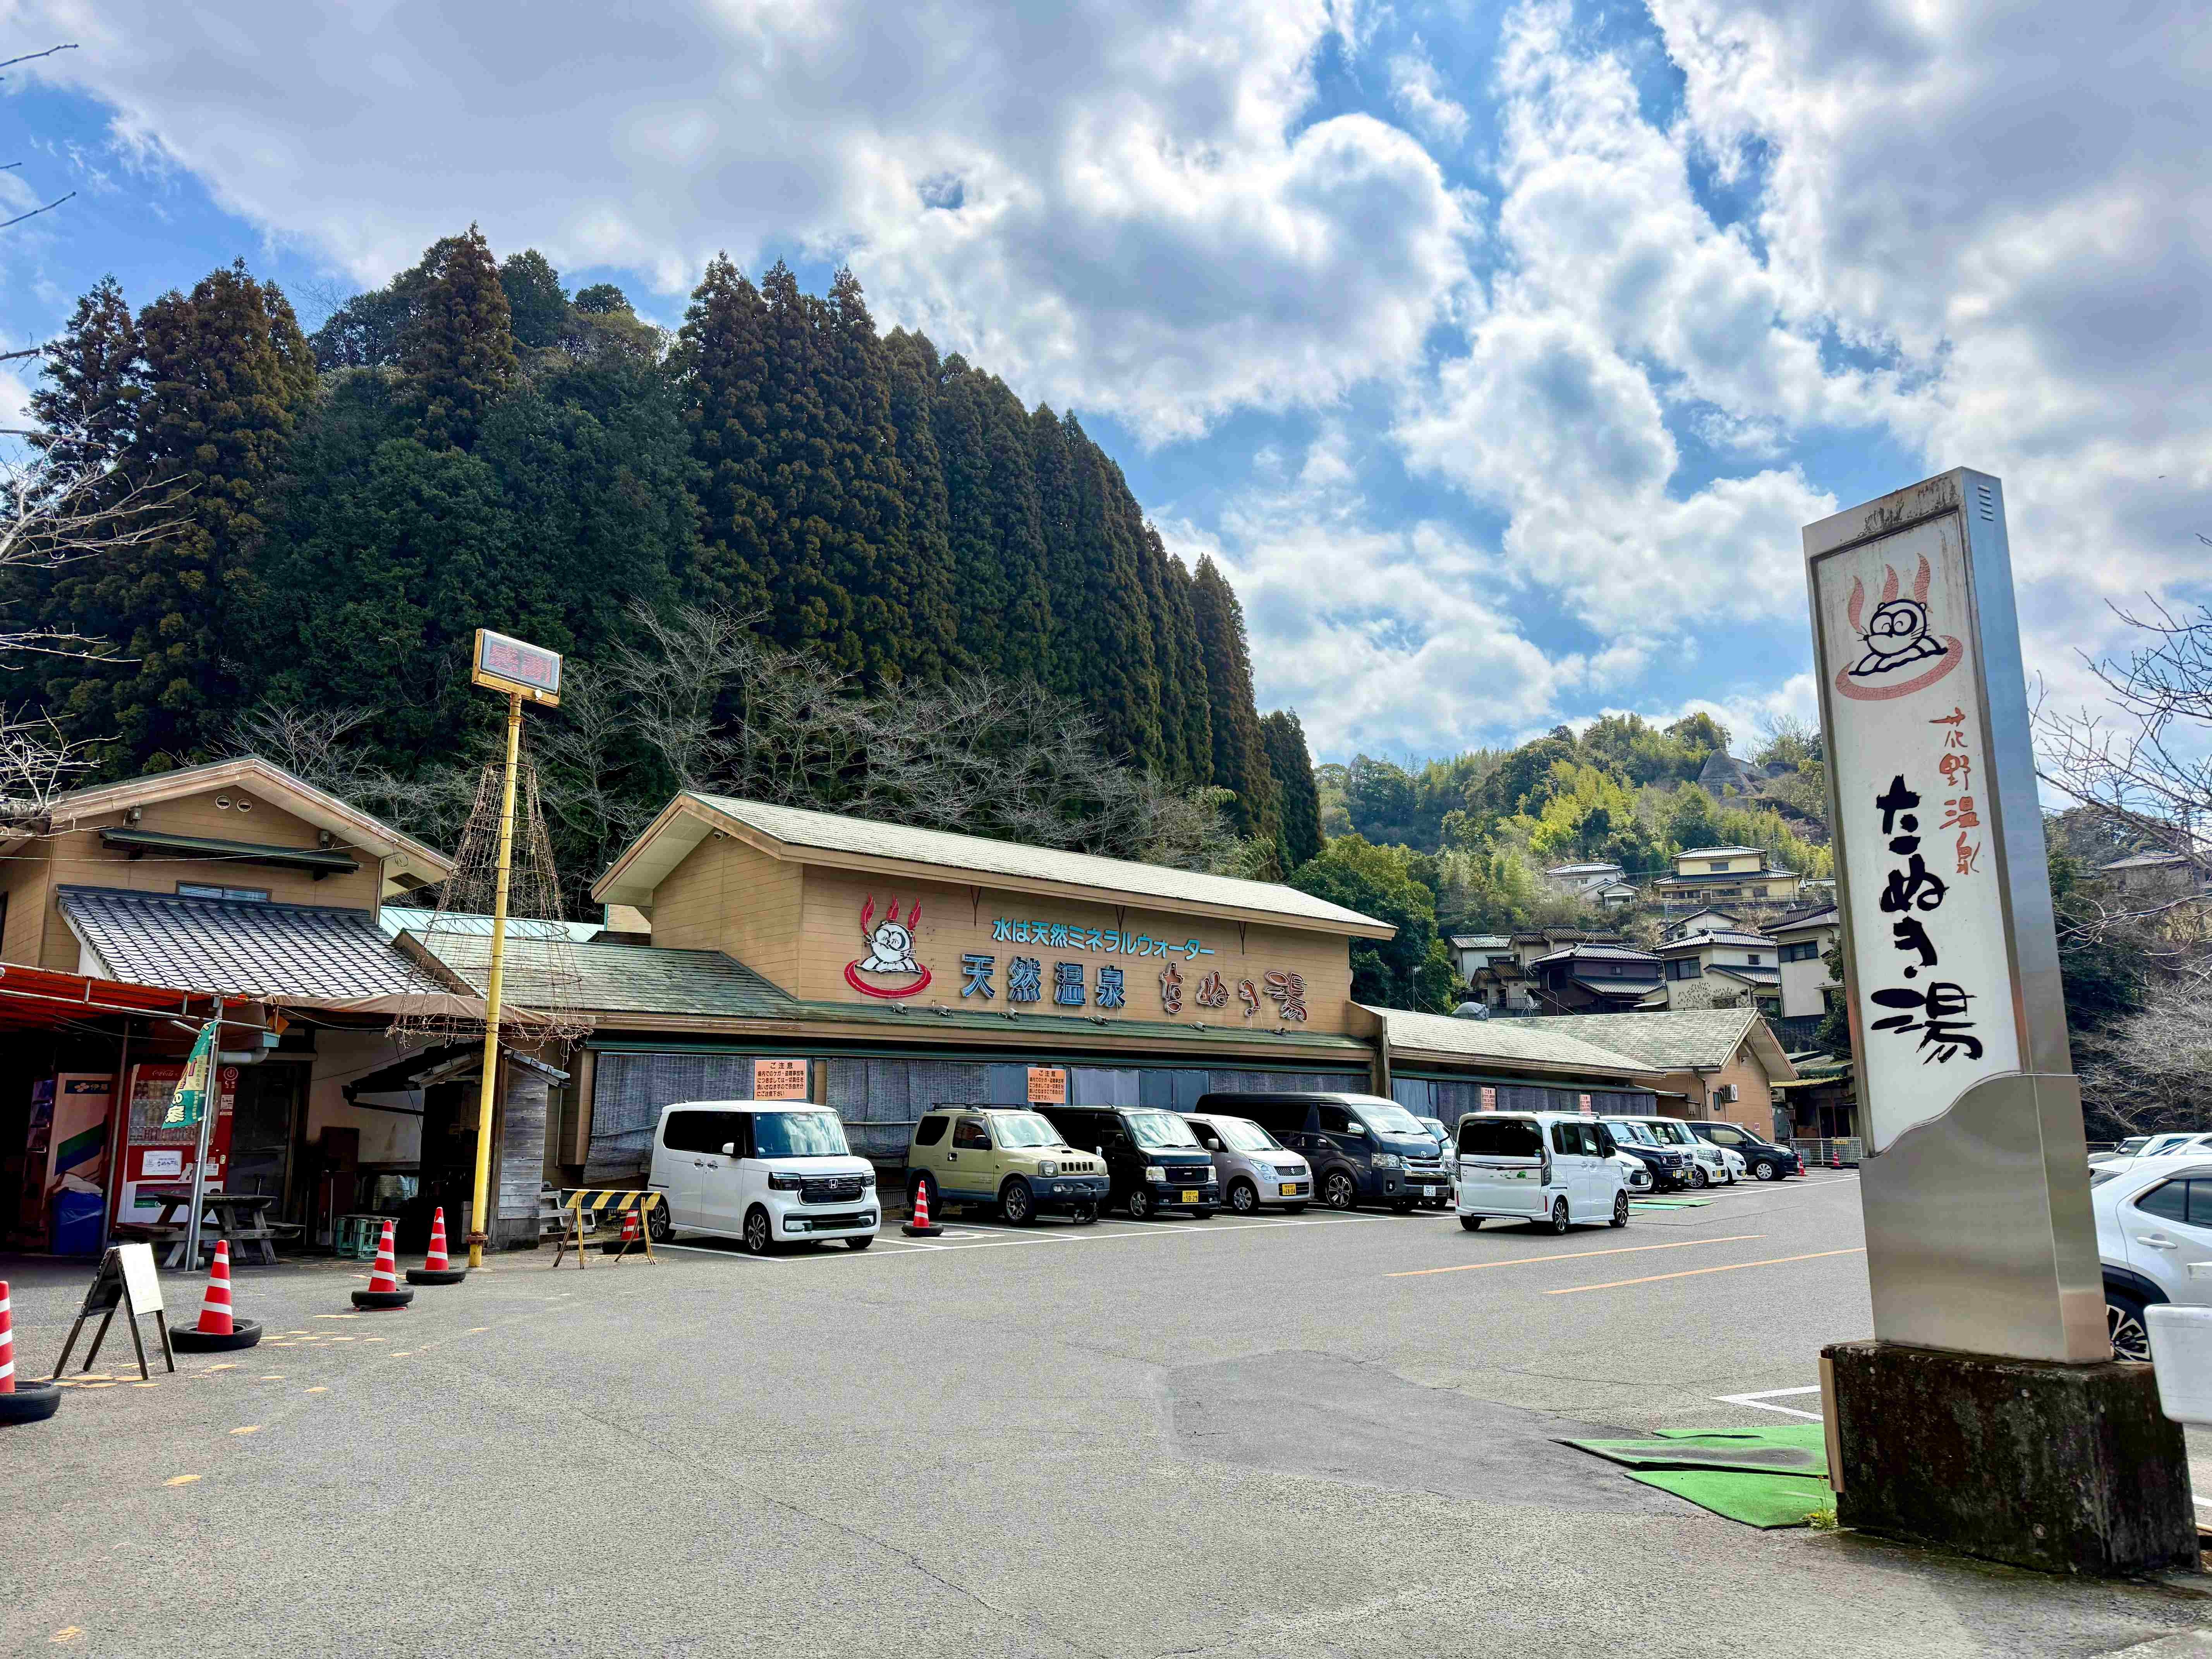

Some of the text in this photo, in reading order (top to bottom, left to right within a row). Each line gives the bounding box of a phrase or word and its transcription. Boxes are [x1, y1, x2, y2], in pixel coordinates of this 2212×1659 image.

[1929, 707, 1980, 874] 花野温泉
[993, 917, 1215, 960] 水は天然ミネラルウォーター
[1871, 774, 1983, 1065] たぬき湯
[960, 953, 1126, 1007] 天然温泉
